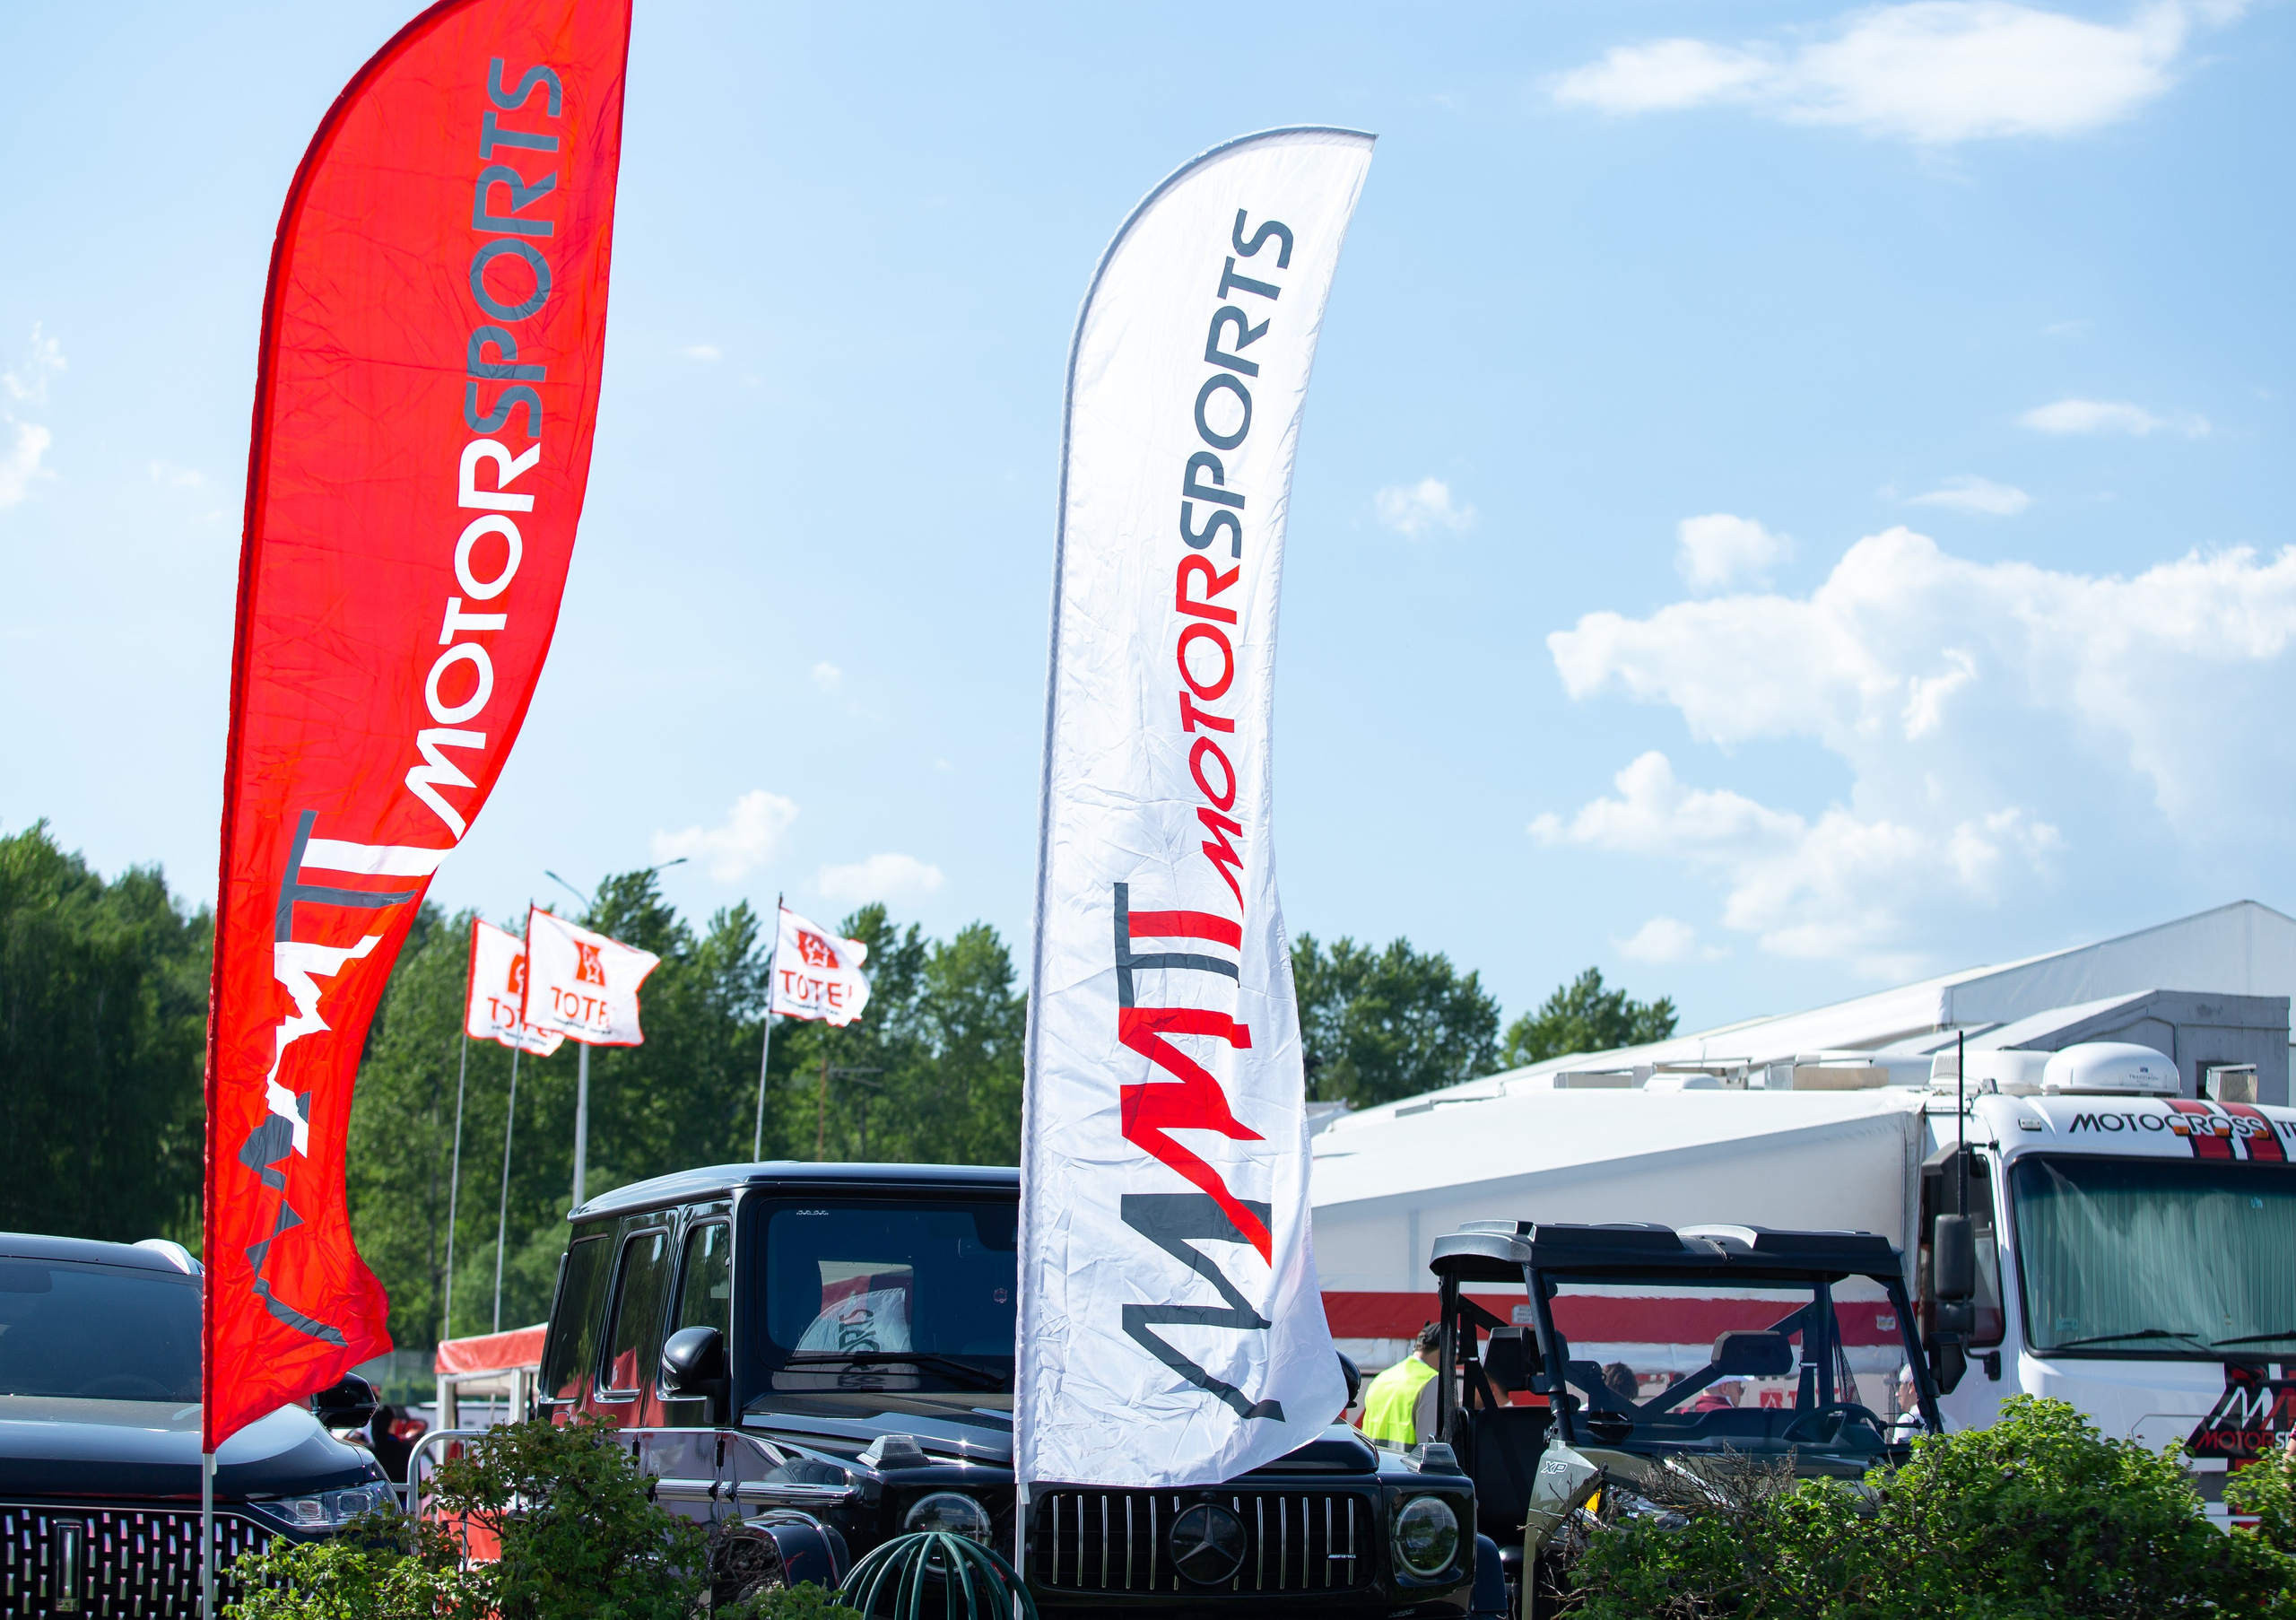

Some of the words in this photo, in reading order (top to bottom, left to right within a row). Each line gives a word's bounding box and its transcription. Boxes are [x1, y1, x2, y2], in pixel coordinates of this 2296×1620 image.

[403, 56, 562, 841] MOTORSPORTS
[1176, 207, 1294, 916] MOTORSPORTS
[2068, 1111, 2269, 1140] MOTOCROSS
[2195, 1430, 2293, 1450] MOTORS
[1540, 1460, 1568, 1475] XP
